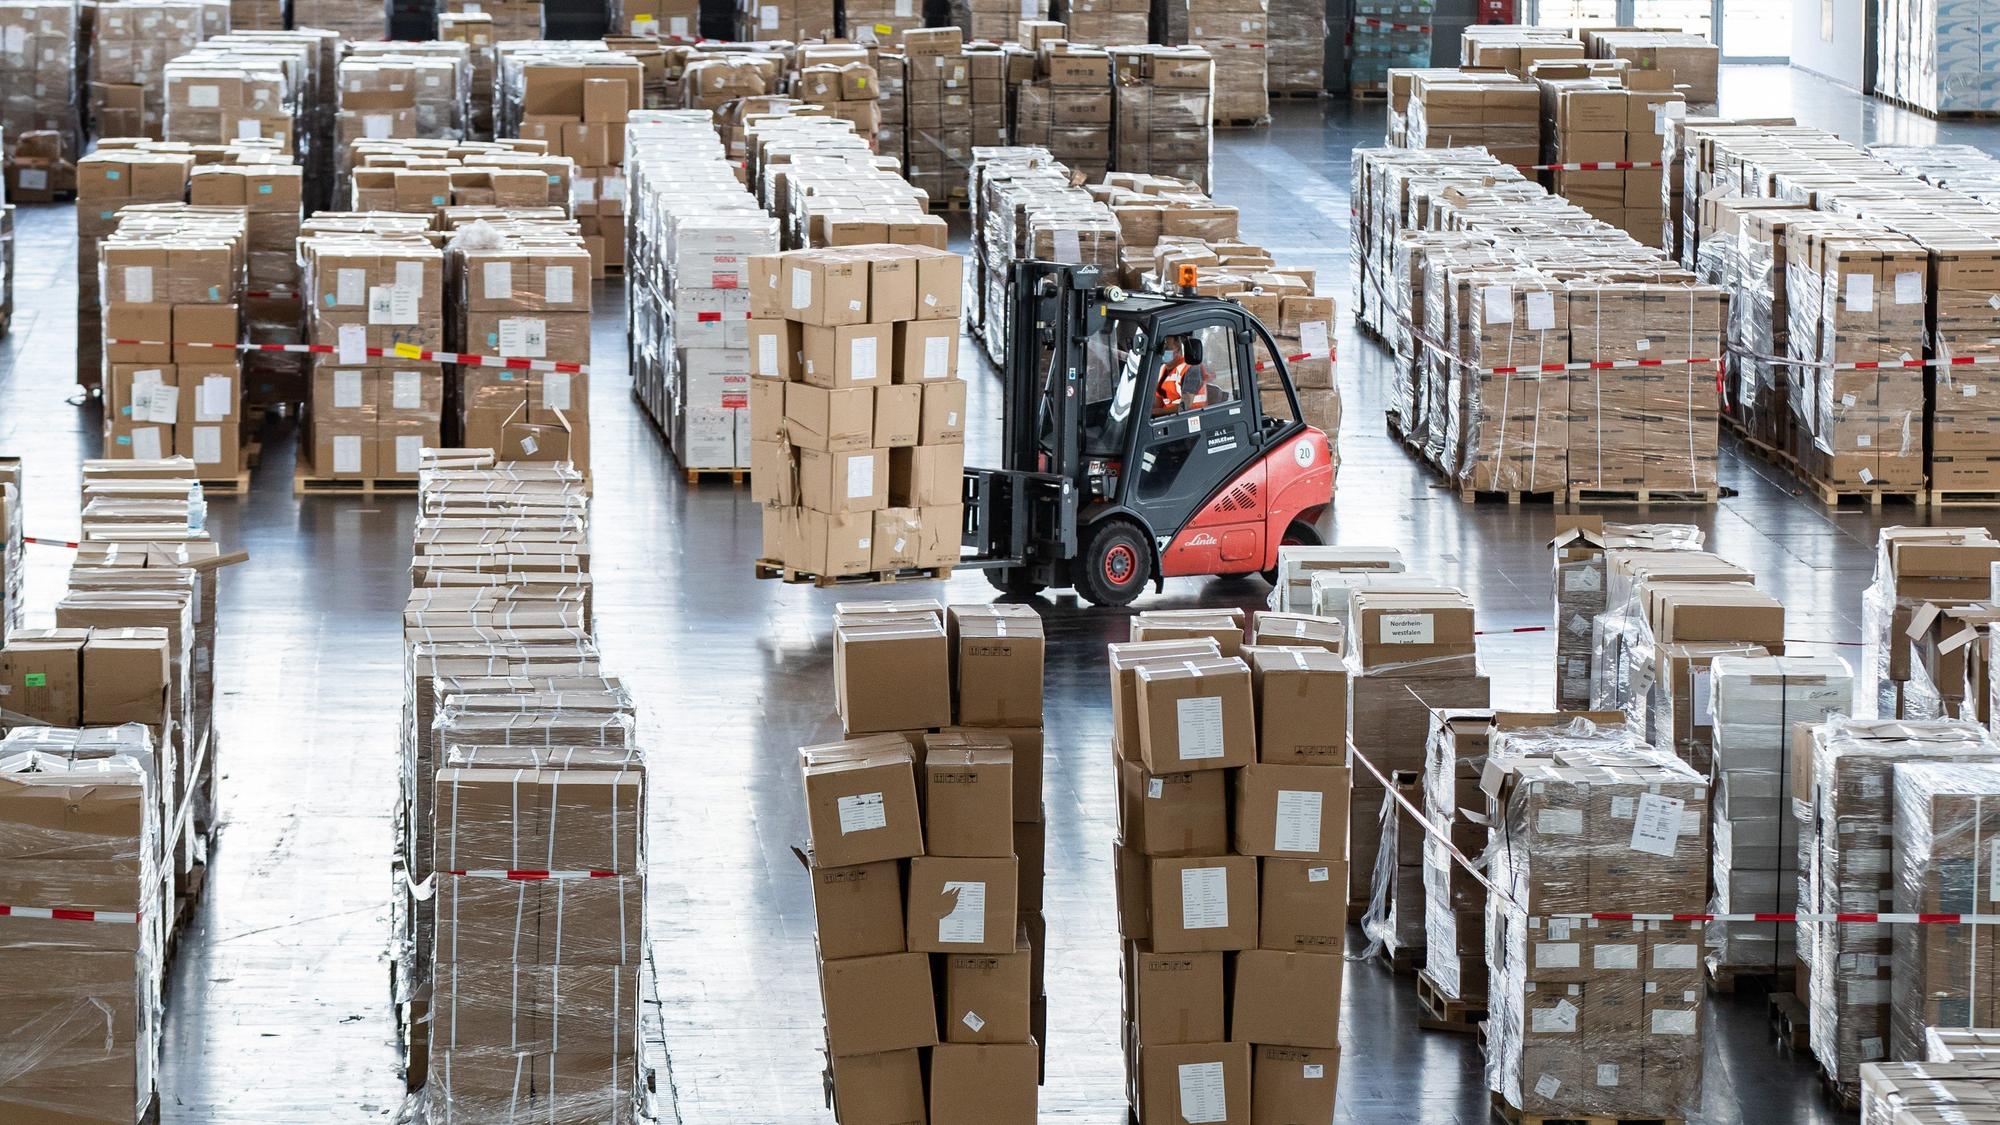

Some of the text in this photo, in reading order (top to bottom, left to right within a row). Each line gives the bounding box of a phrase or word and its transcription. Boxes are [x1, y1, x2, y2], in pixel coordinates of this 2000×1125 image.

[1076, 264, 1099, 274] Linde
[1299, 448, 1311, 459] 20
[1184, 532, 1217, 547] Linde
